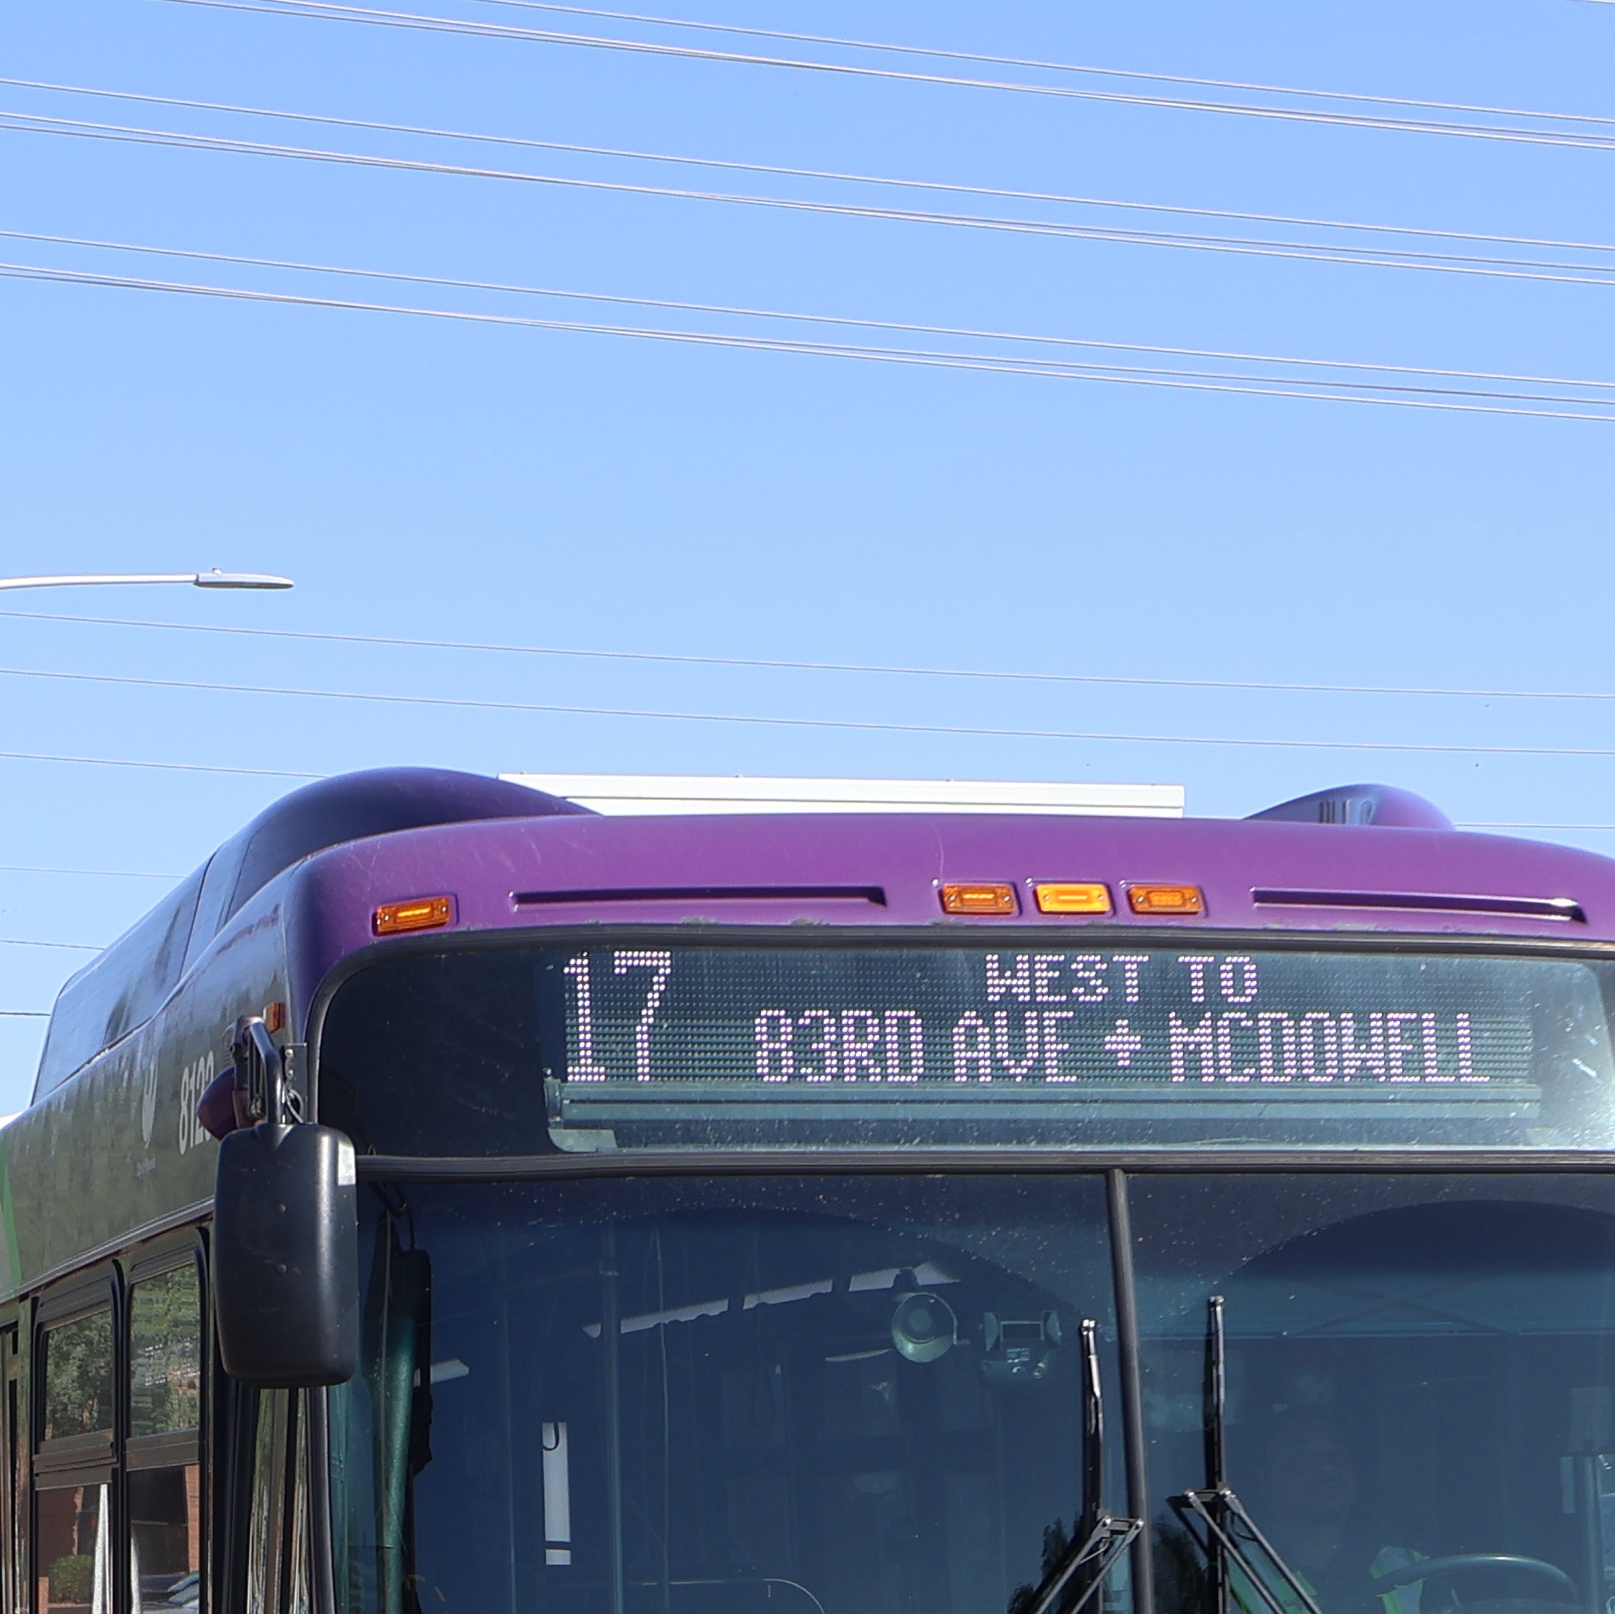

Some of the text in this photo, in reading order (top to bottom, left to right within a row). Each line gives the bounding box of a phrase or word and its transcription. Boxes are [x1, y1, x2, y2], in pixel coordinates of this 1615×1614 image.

[986, 954, 1258, 1003] WEST TO
[563, 951, 672, 1082] 17
[754, 1009, 924, 1083] 83RD
[952, 1010, 1078, 1083] AVE
[1169, 1011, 1490, 1083] MCDOWELL
